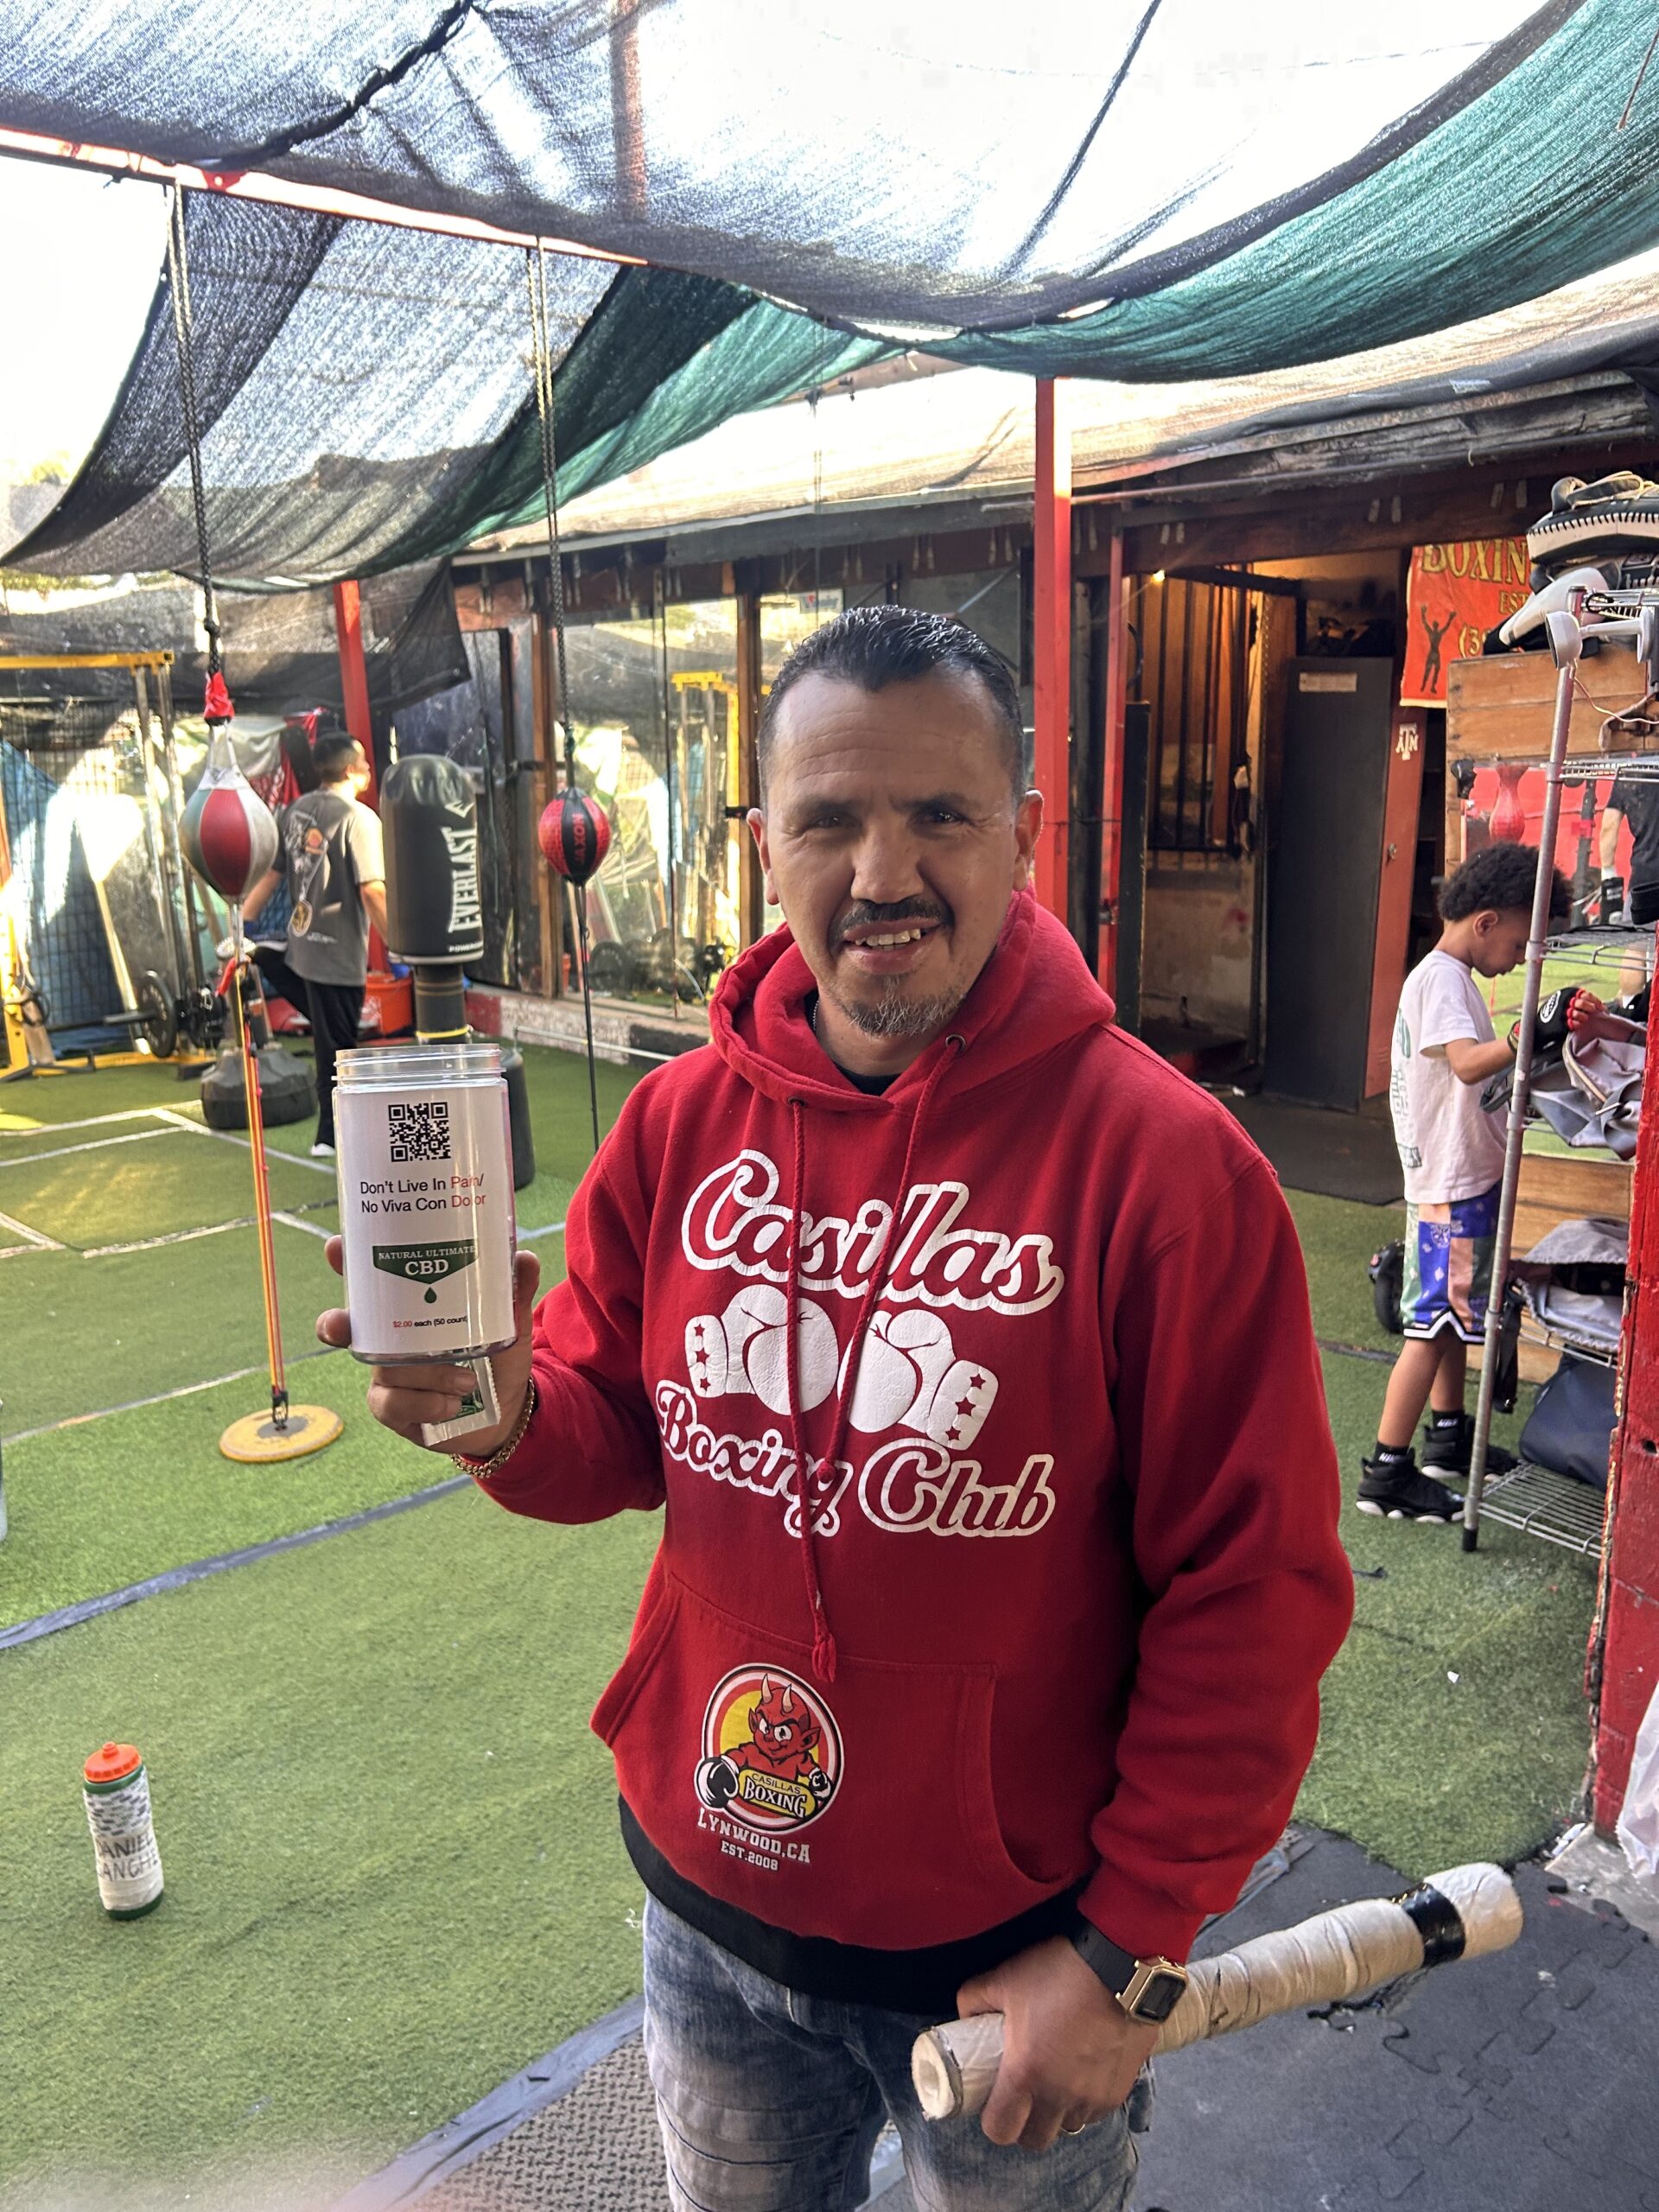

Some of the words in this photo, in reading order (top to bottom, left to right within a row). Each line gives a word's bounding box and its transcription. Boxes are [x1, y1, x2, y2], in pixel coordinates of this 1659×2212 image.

[1421, 539, 1535, 585] BOXIN
[441, 826, 482, 933] EVERLAST
[360, 1181, 394, 1194] Don't
[398, 1179, 429, 1193] Live
[433, 1178, 446, 1191] In
[361, 1199, 378, 1213] No
[381, 1199, 412, 1212] Viva
[416, 1198, 447, 1211] Con
[451, 1194, 486, 1208] Door
[681, 1148, 1065, 1316] Casillas
[378, 1250, 423, 1260] NATURAL
[426, 1245, 476, 1258] ULTIMATE
[405, 1259, 449, 1275] CBD
[414, 1319, 432, 1327] each
[433, 1318, 445, 1326] (50
[655, 1380, 854, 1538] Boxing
[857, 1437, 1057, 1537] Club
[744, 1777, 808, 1818] BOXING
[751, 1773, 802, 1795] CASILLAS
[697, 1808, 810, 1863] LYNWOOD,CA
[721, 1840, 779, 1872] EST.2008
